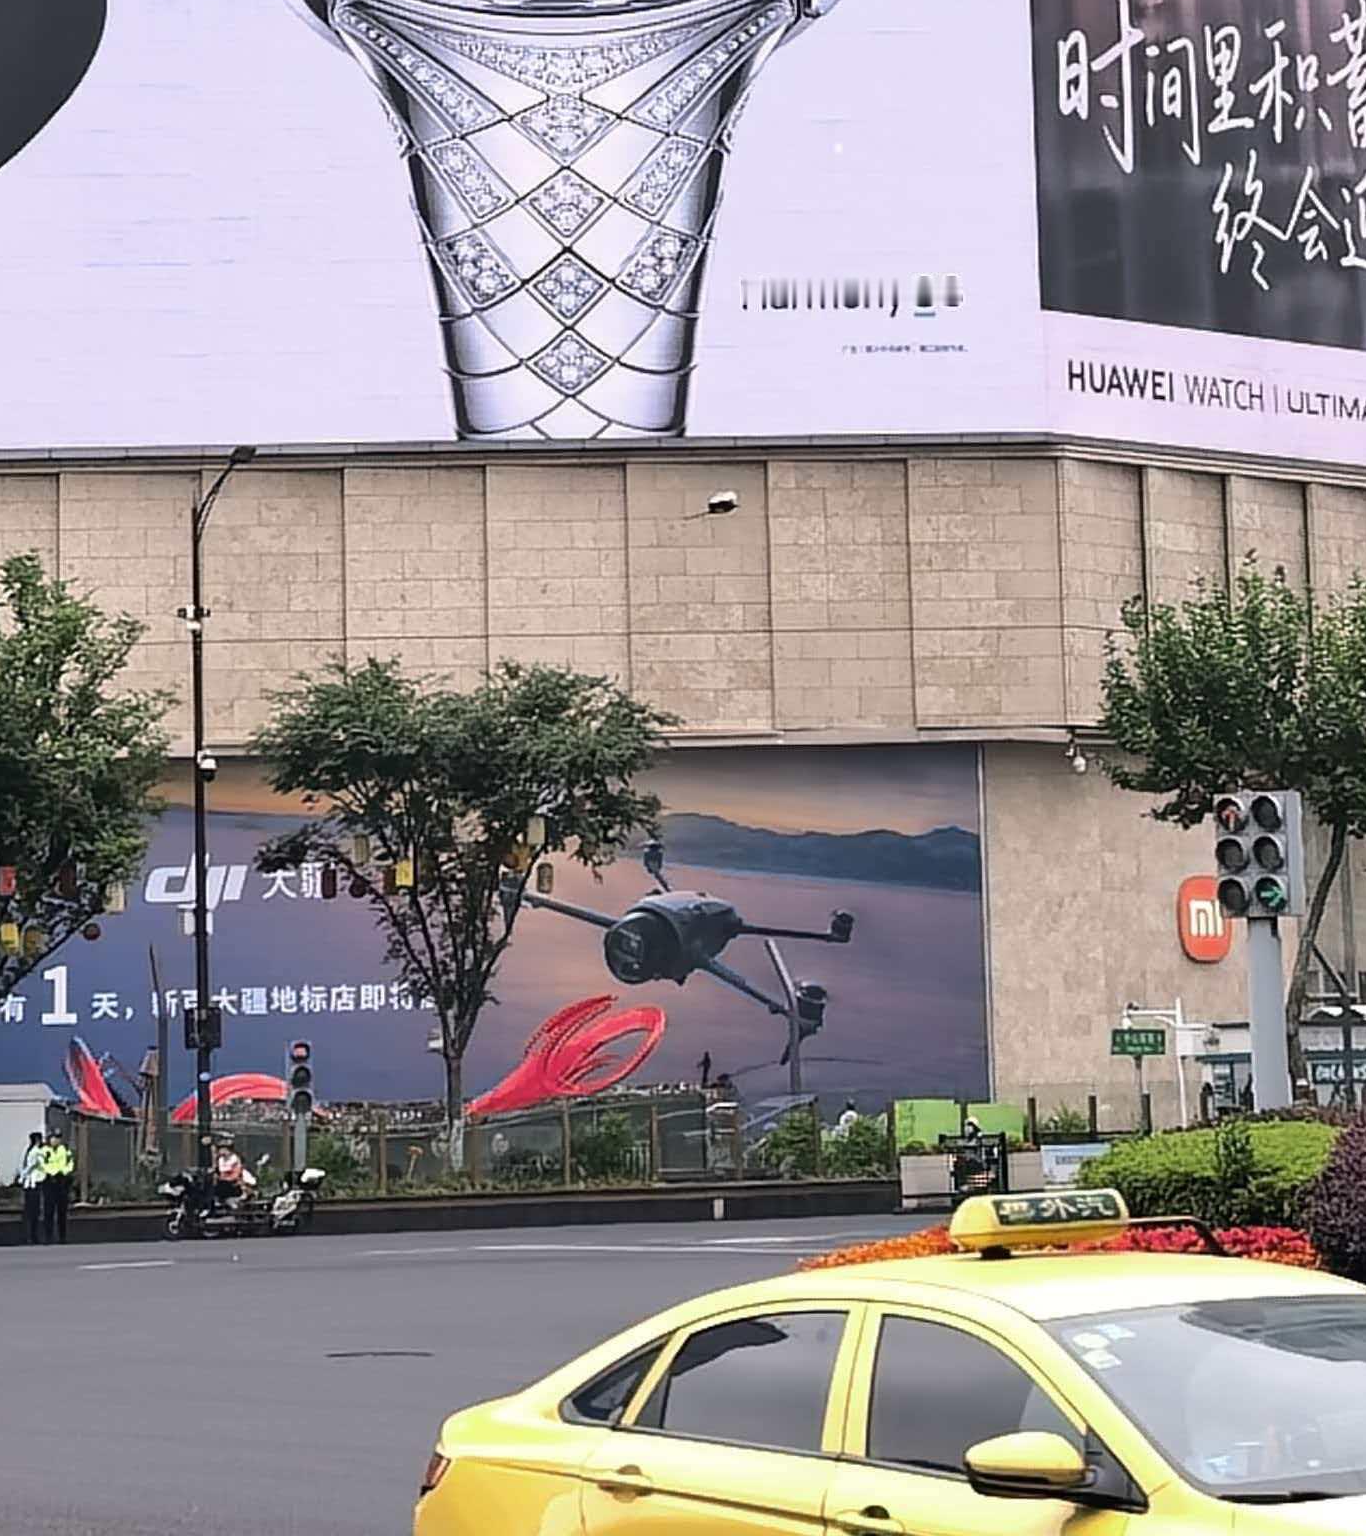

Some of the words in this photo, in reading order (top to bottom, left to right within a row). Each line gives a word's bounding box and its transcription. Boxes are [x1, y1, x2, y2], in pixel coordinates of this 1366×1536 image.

[1067, 358, 1175, 403] HUAWEI
[1184, 373, 1265, 413] WATCH
[41, 964, 78, 1026] 1
